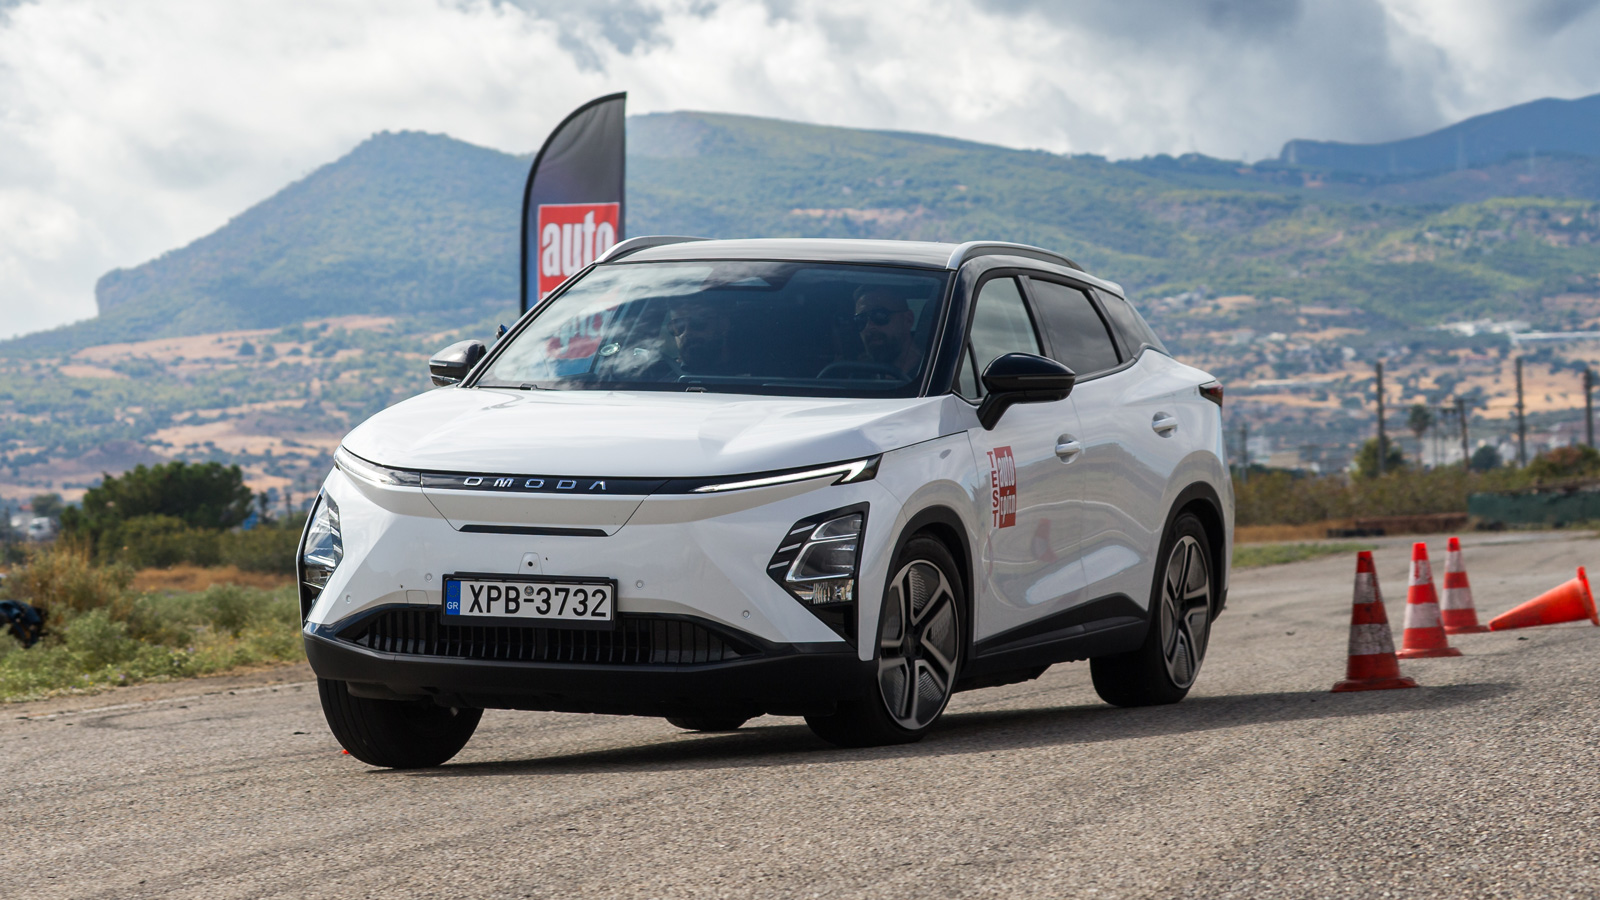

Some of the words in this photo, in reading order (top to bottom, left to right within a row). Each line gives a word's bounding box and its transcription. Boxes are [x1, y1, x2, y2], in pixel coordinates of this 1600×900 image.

[542, 210, 615, 277] auto
[463, 476, 607, 490] OMODA
[997, 450, 1015, 487] auto
[986, 451, 999, 528] TEST
[446, 602, 459, 610] GR
[468, 584, 608, 618] XPB-3732
